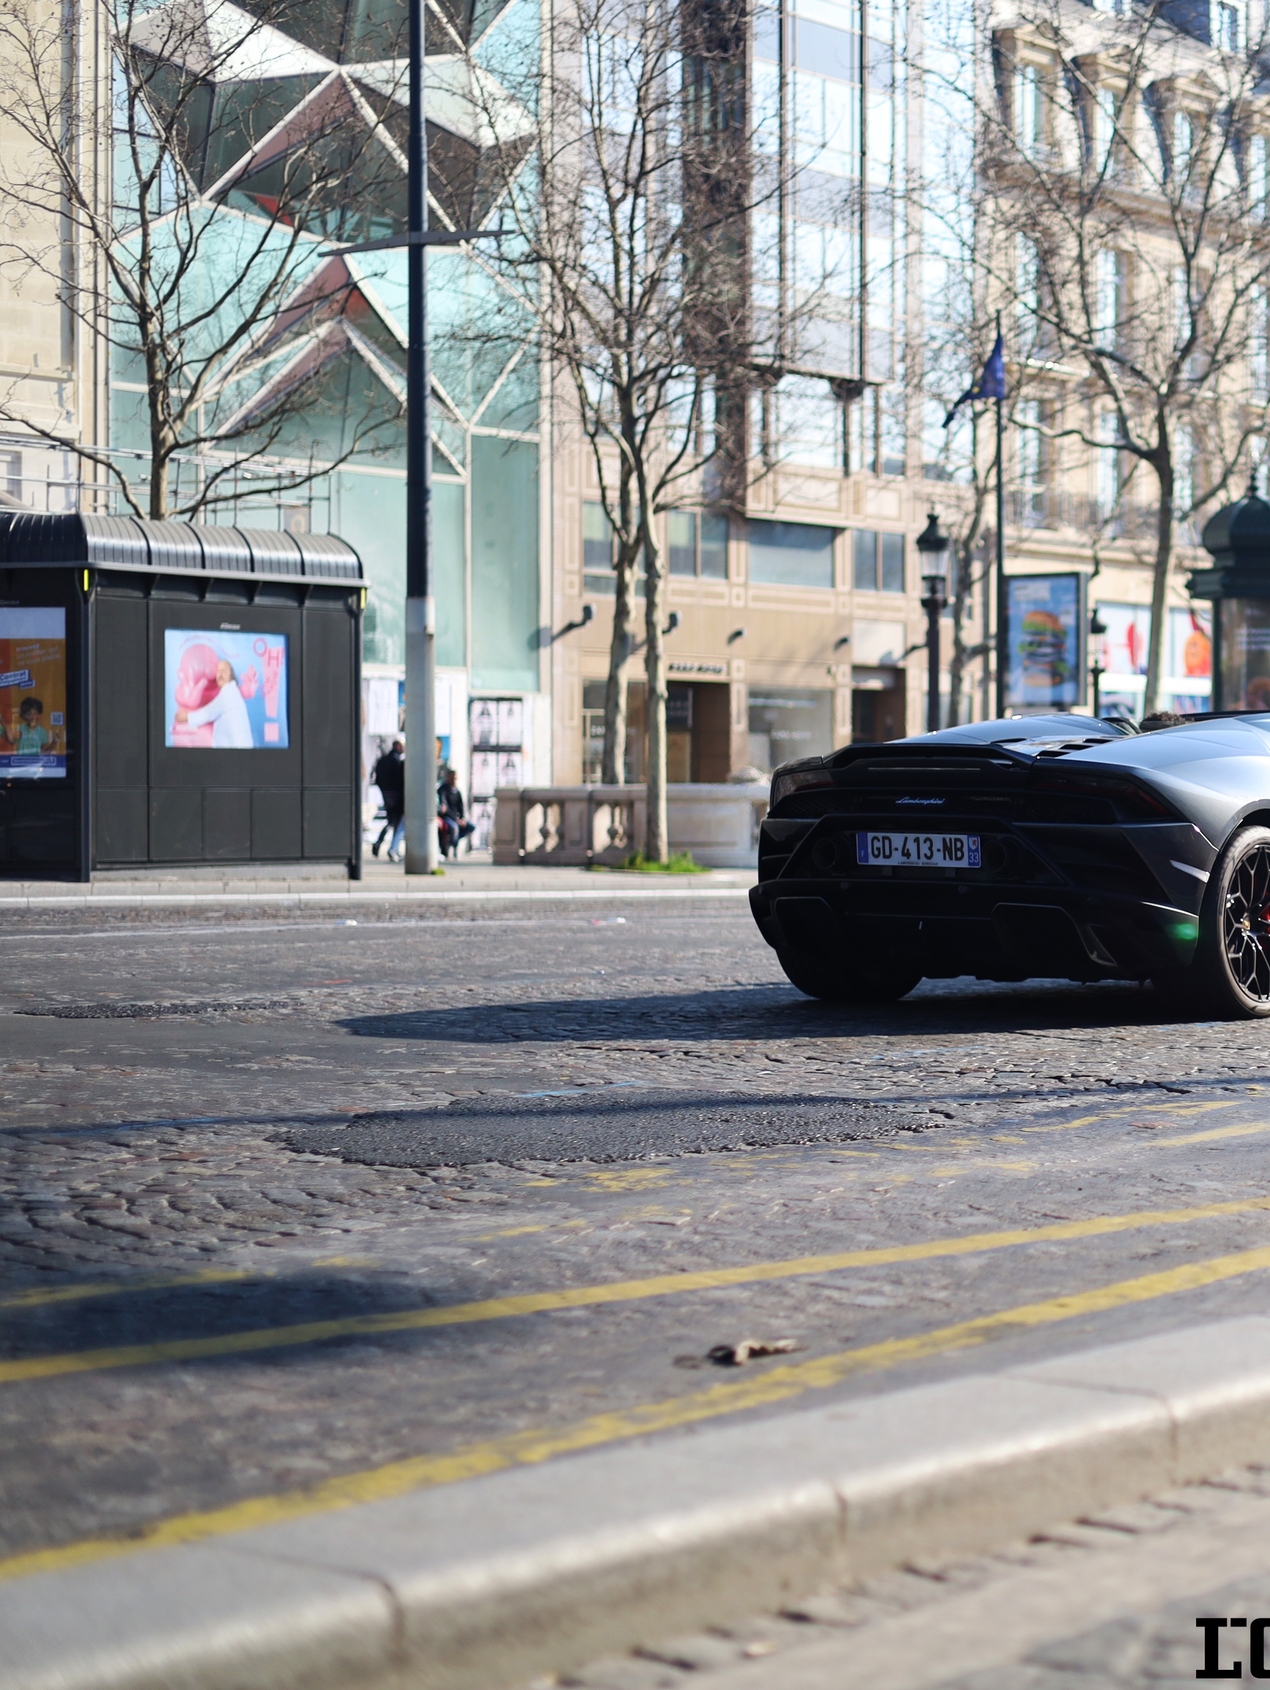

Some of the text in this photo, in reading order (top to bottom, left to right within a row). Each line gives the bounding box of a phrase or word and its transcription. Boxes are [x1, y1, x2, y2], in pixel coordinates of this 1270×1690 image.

[895, 796, 945, 805] Lamborghini
[871, 835, 965, 861] GD-413-NB
[969, 852, 979, 863] 33
